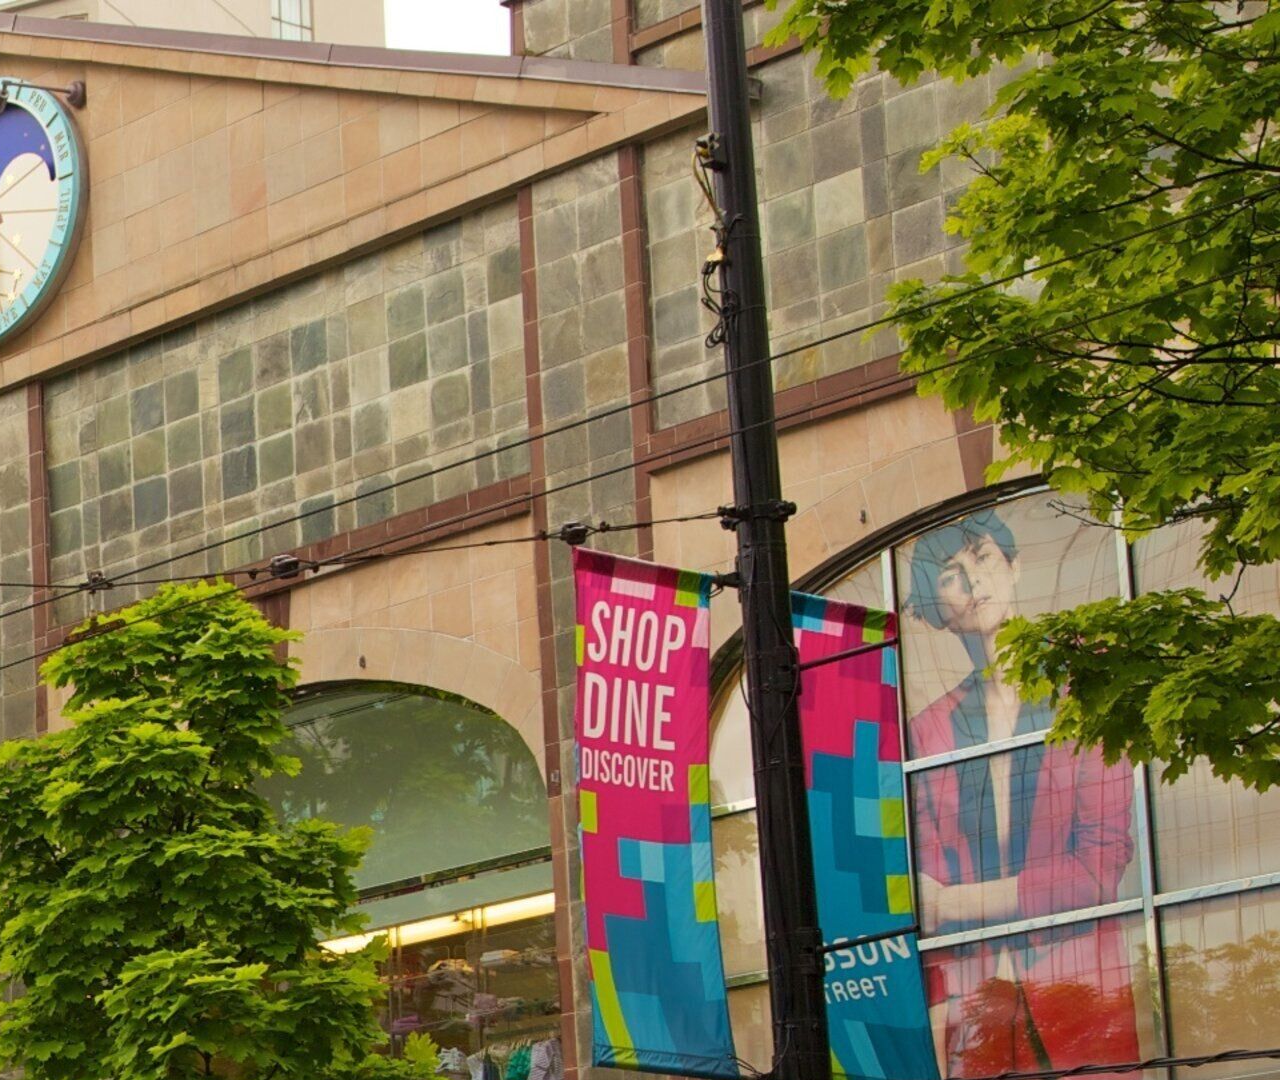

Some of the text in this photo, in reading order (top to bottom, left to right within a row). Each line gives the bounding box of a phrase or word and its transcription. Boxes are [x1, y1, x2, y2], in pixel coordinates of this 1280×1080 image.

[29, 90, 47, 113] FEB
[54, 131, 69, 162] MAR
[55, 187, 71, 232] APRIL
[32, 259, 52, 290] MAY
[587, 600, 686, 673] SHOP
[583, 671, 676, 751] DINE
[581, 746, 674, 792] DISCOVER
